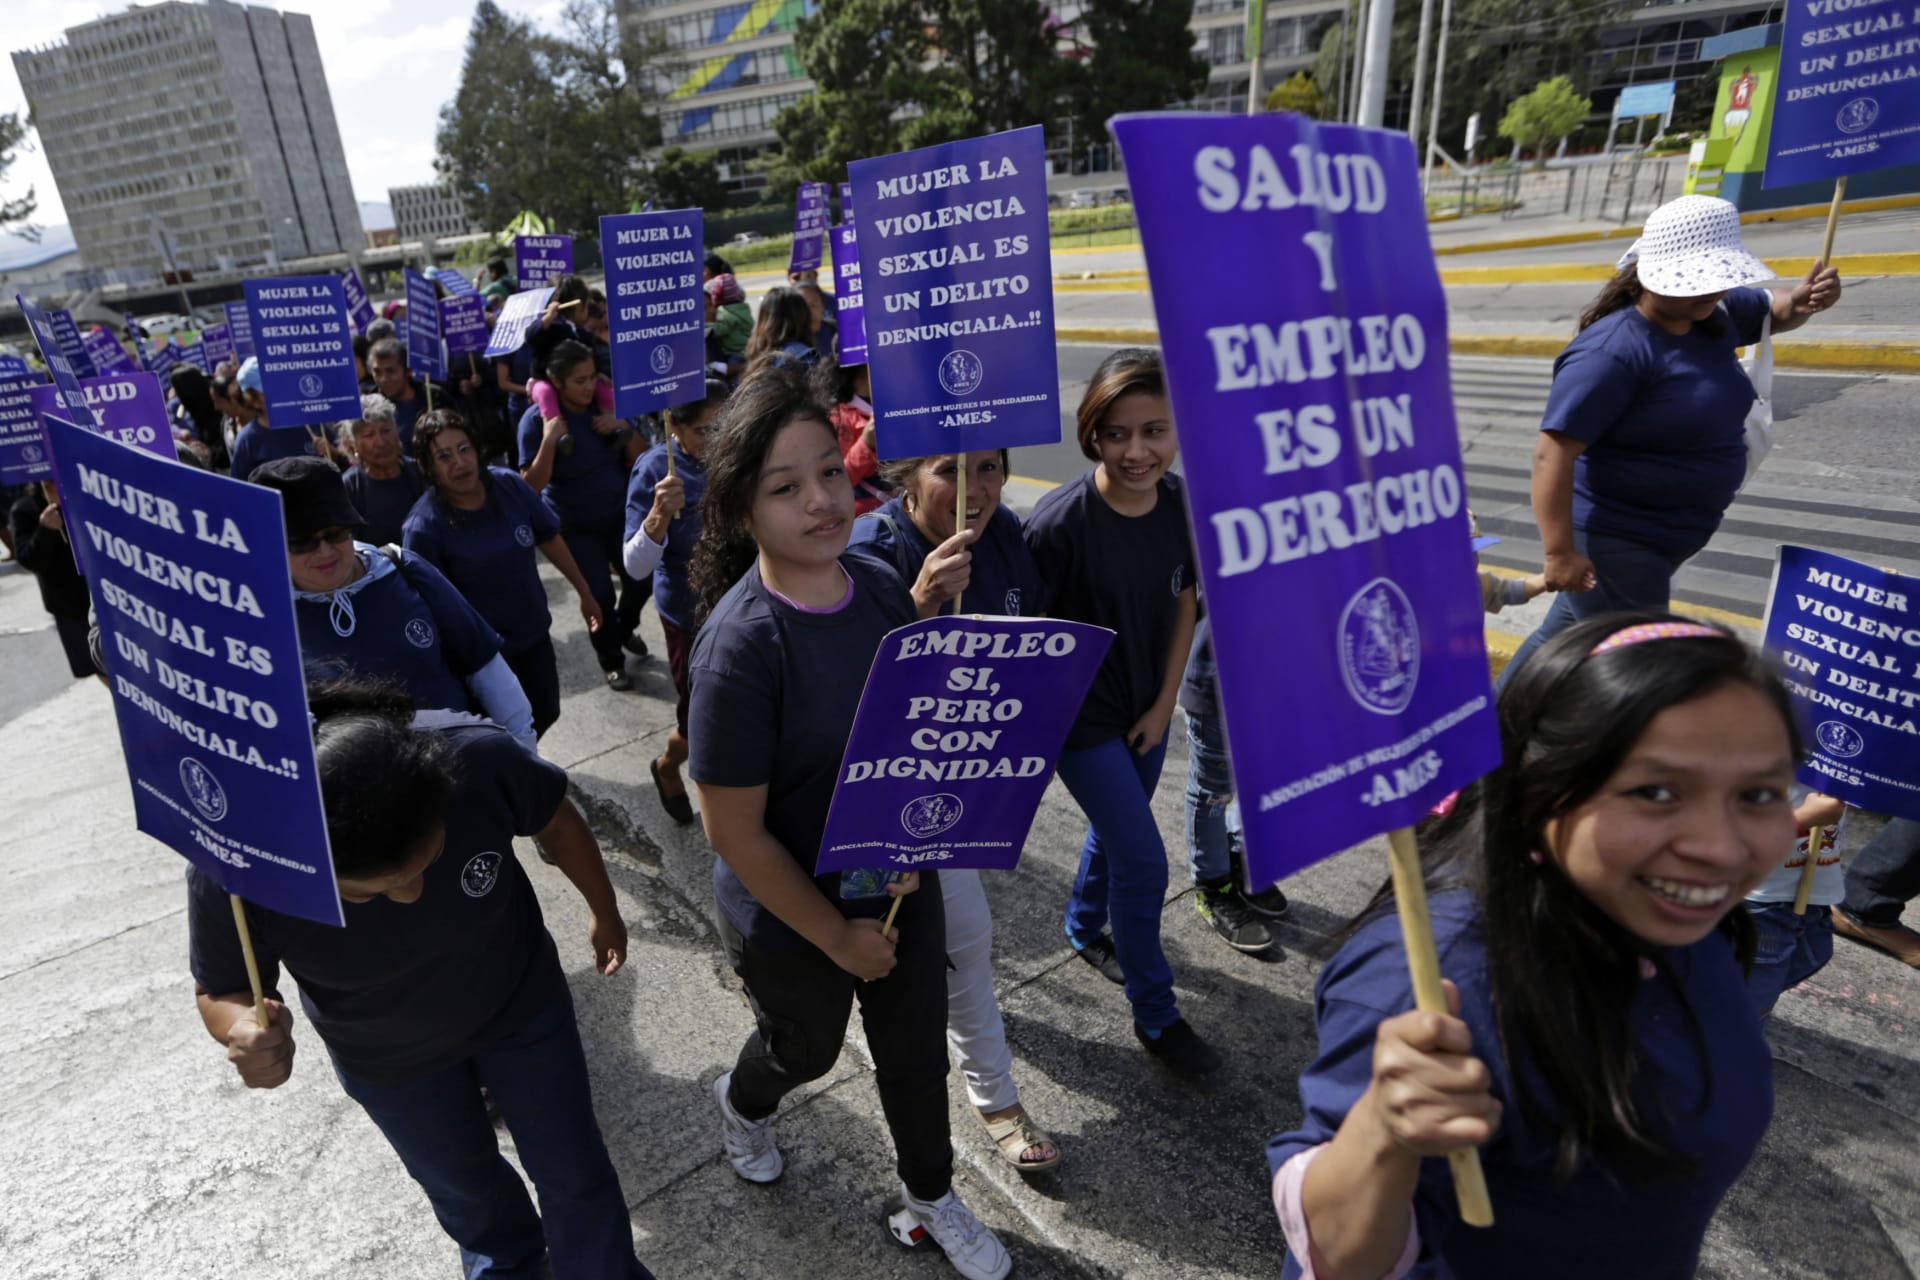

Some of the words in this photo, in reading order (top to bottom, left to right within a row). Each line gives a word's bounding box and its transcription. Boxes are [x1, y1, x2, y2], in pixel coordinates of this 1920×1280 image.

[1801, 12, 1904, 47] SEXUAL
[1800, 55, 1837, 75] UN
[1845, 37, 1920, 67] DELIT
[1826, 142, 1880, 158] -AMES-
[876, 163, 970, 200] MUJER
[980, 156, 1018, 181] LA
[1194, 143, 1387, 214] SALUD
[875, 196, 1026, 239] VIOLENCIA
[617, 227, 669, 245] MUJER
[673, 225, 692, 239] LA
[615, 250, 695, 271] VIOLENCIA
[878, 242, 985, 276] SEXUAL
[994, 234, 1029, 257] ES
[1303, 230, 1337, 291] Y
[258, 286, 309, 301] MUJER
[312, 285, 332, 297] LA
[617, 277, 676, 296] SEXUAL
[680, 274, 696, 288] ES
[884, 290, 921, 314] UN
[930, 274, 1030, 308] DELITO
[258, 304, 336, 319] VIOLENCIA
[620, 306, 642, 321] UN
[646, 298, 695, 318] DELITO
[262, 324, 319, 338] SEXUAL
[322, 322, 340, 333] ES
[877, 310, 1042, 347] DENUNCIALA..!!
[266, 345, 287, 356] UN
[291, 341, 342, 355] DELITO
[1206, 313, 1426, 392] EMPLEO
[55, 382, 137, 409] SLUD
[884, 406, 930, 418] ASOCIACIÓN
[931, 403, 942, 413] DE
[992, 394, 1048, 406] SOLIDARIDAD
[91, 408, 106, 426] Y
[938, 410, 997, 428] -AMES-
[1255, 404, 1342, 475] ES
[1352, 393, 1415, 458] UN
[77, 463, 185, 534] MUJER
[192, 509, 249, 553] LA
[1210, 464, 1461, 578] DERECHO
[84, 520, 265, 618] VIOLENCIA
[1806, 567, 1908, 613] MUJER
[100, 578, 215, 658] SEXUAL
[224, 635, 274, 676] ES
[895, 630, 1077, 662] EMPLEO
[1785, 623, 1901, 674] SEXUAL
[1783, 650, 1821, 676] UN
[114, 631, 150, 674] UN
[155, 657, 278, 729] DELITO
[946, 667, 1001, 696] SI,
[905, 696, 1023, 723] PERO
[115, 673, 300, 780] DENUNCIALA..!!
[910, 727, 1002, 753] CON
[844, 756, 1046, 784] DIGNIDAD
[1850, 765, 1863, 775] EN
[190, 828, 251, 869] -AMES-
[227, 837, 241, 849] EN
[243, 842, 317, 874] SOLIDARIDAD
[829, 840, 884, 852] ASOCIACIÓN
[885, 842, 898, 850] DE
[899, 842, 939, 853] MUJERES
[889, 850, 955, 865] -AMES-
